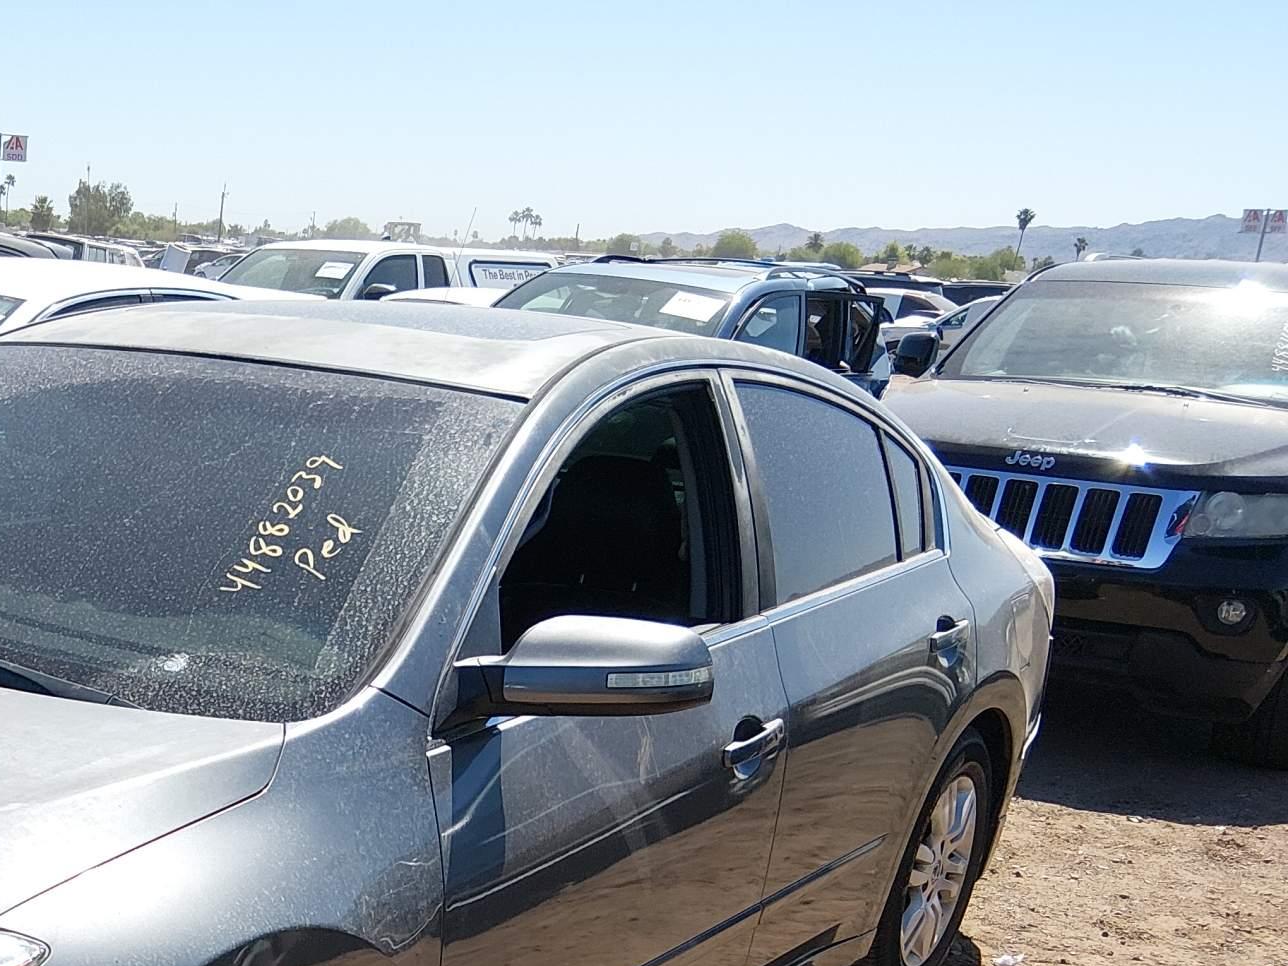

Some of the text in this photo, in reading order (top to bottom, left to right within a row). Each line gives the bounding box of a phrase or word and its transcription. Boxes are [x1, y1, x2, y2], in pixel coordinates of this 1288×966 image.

[482, 268, 499, 281] The
[498, 269, 516, 281] Best
[516, 269, 525, 281] in
[1005, 450, 1056, 471] Jeep
[219, 455, 344, 592] 44882039
